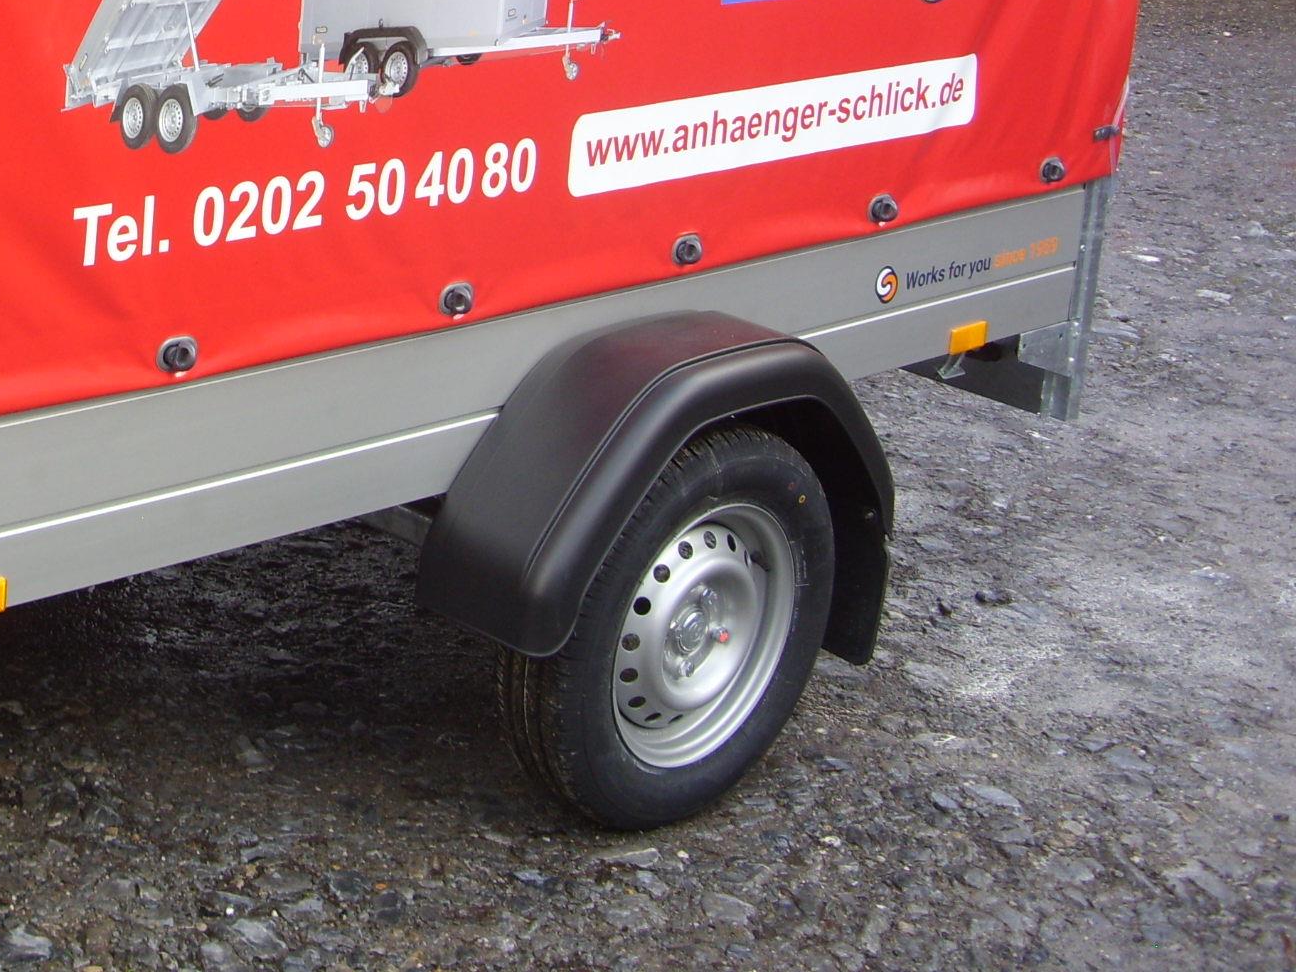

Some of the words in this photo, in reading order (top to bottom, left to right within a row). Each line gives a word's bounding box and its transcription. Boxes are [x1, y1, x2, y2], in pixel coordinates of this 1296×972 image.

[585, 72, 964, 167] www.anhaenger-schlick.de
[72, 195, 170, 267] Tel.
[193, 170, 325, 247] 0202
[906, 267, 945, 291] Works
[949, 260, 967, 279] for
[969, 257, 992, 280] you
